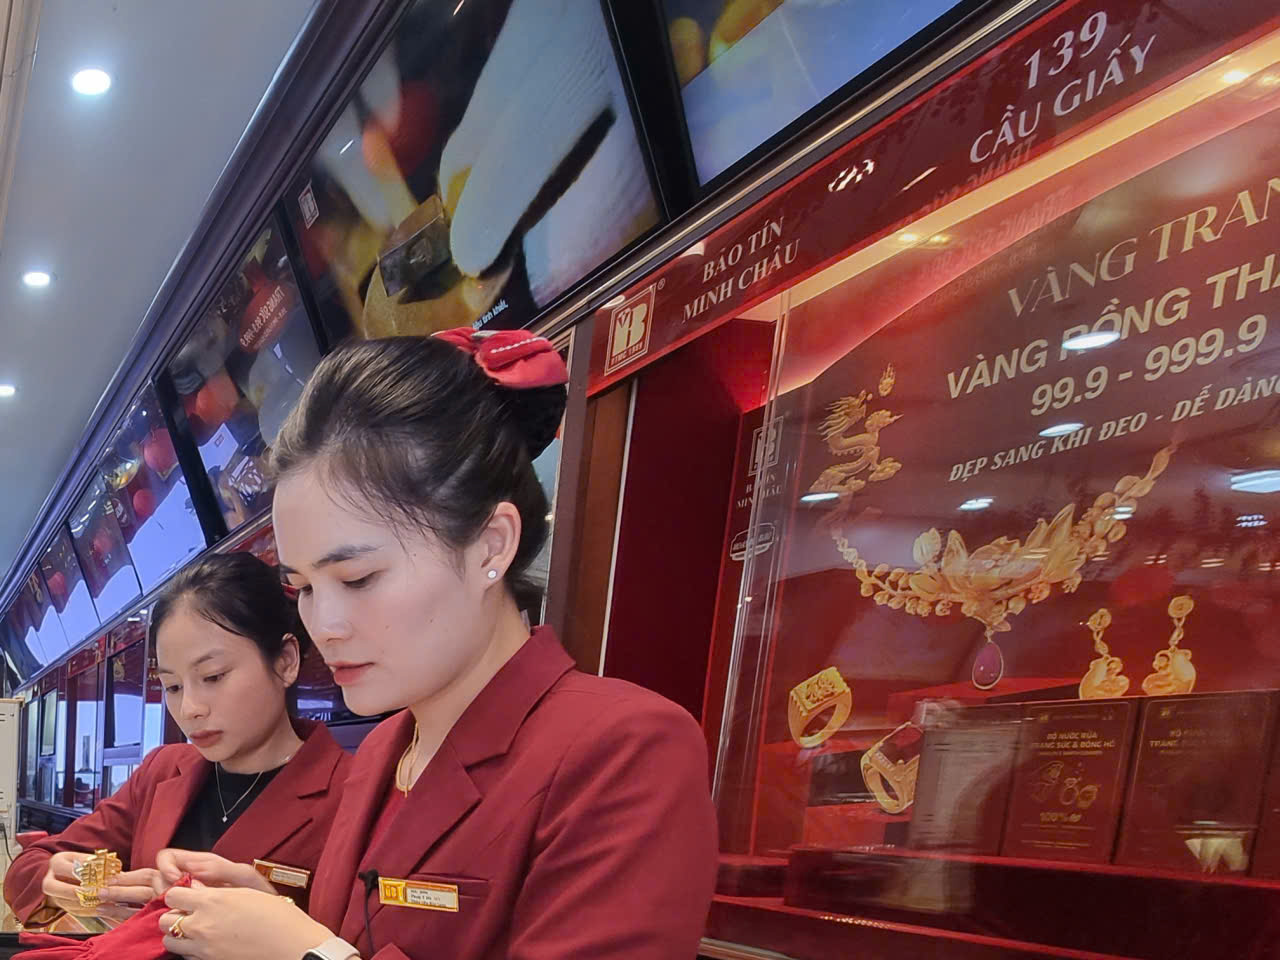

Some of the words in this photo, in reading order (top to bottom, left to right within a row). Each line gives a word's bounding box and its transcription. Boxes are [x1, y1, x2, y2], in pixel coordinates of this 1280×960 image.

[1024, 11, 1107, 89] 139
[970, 102, 1041, 163] CẦU
[1053, 33, 1157, 116] GIẤY
[681, 276, 735, 324] MINH
[738, 239, 801, 290] CHÂU
[702, 243, 743, 283] BẢO
[748, 216, 785, 256] TÍN
[1007, 237, 1138, 317] VÀNG
[947, 339, 1049, 400] VÀNG
[1031, 366, 1109, 416] 99.9
[1144, 314, 1268, 382] 999.9
[948, 456, 988, 483] ĐẸP
[990, 440, 1045, 470] SANG
[1050, 427, 1093, 455] KHI
[1098, 411, 1148, 442] ĐEO
[1171, 384, 1212, 423] DỄ
